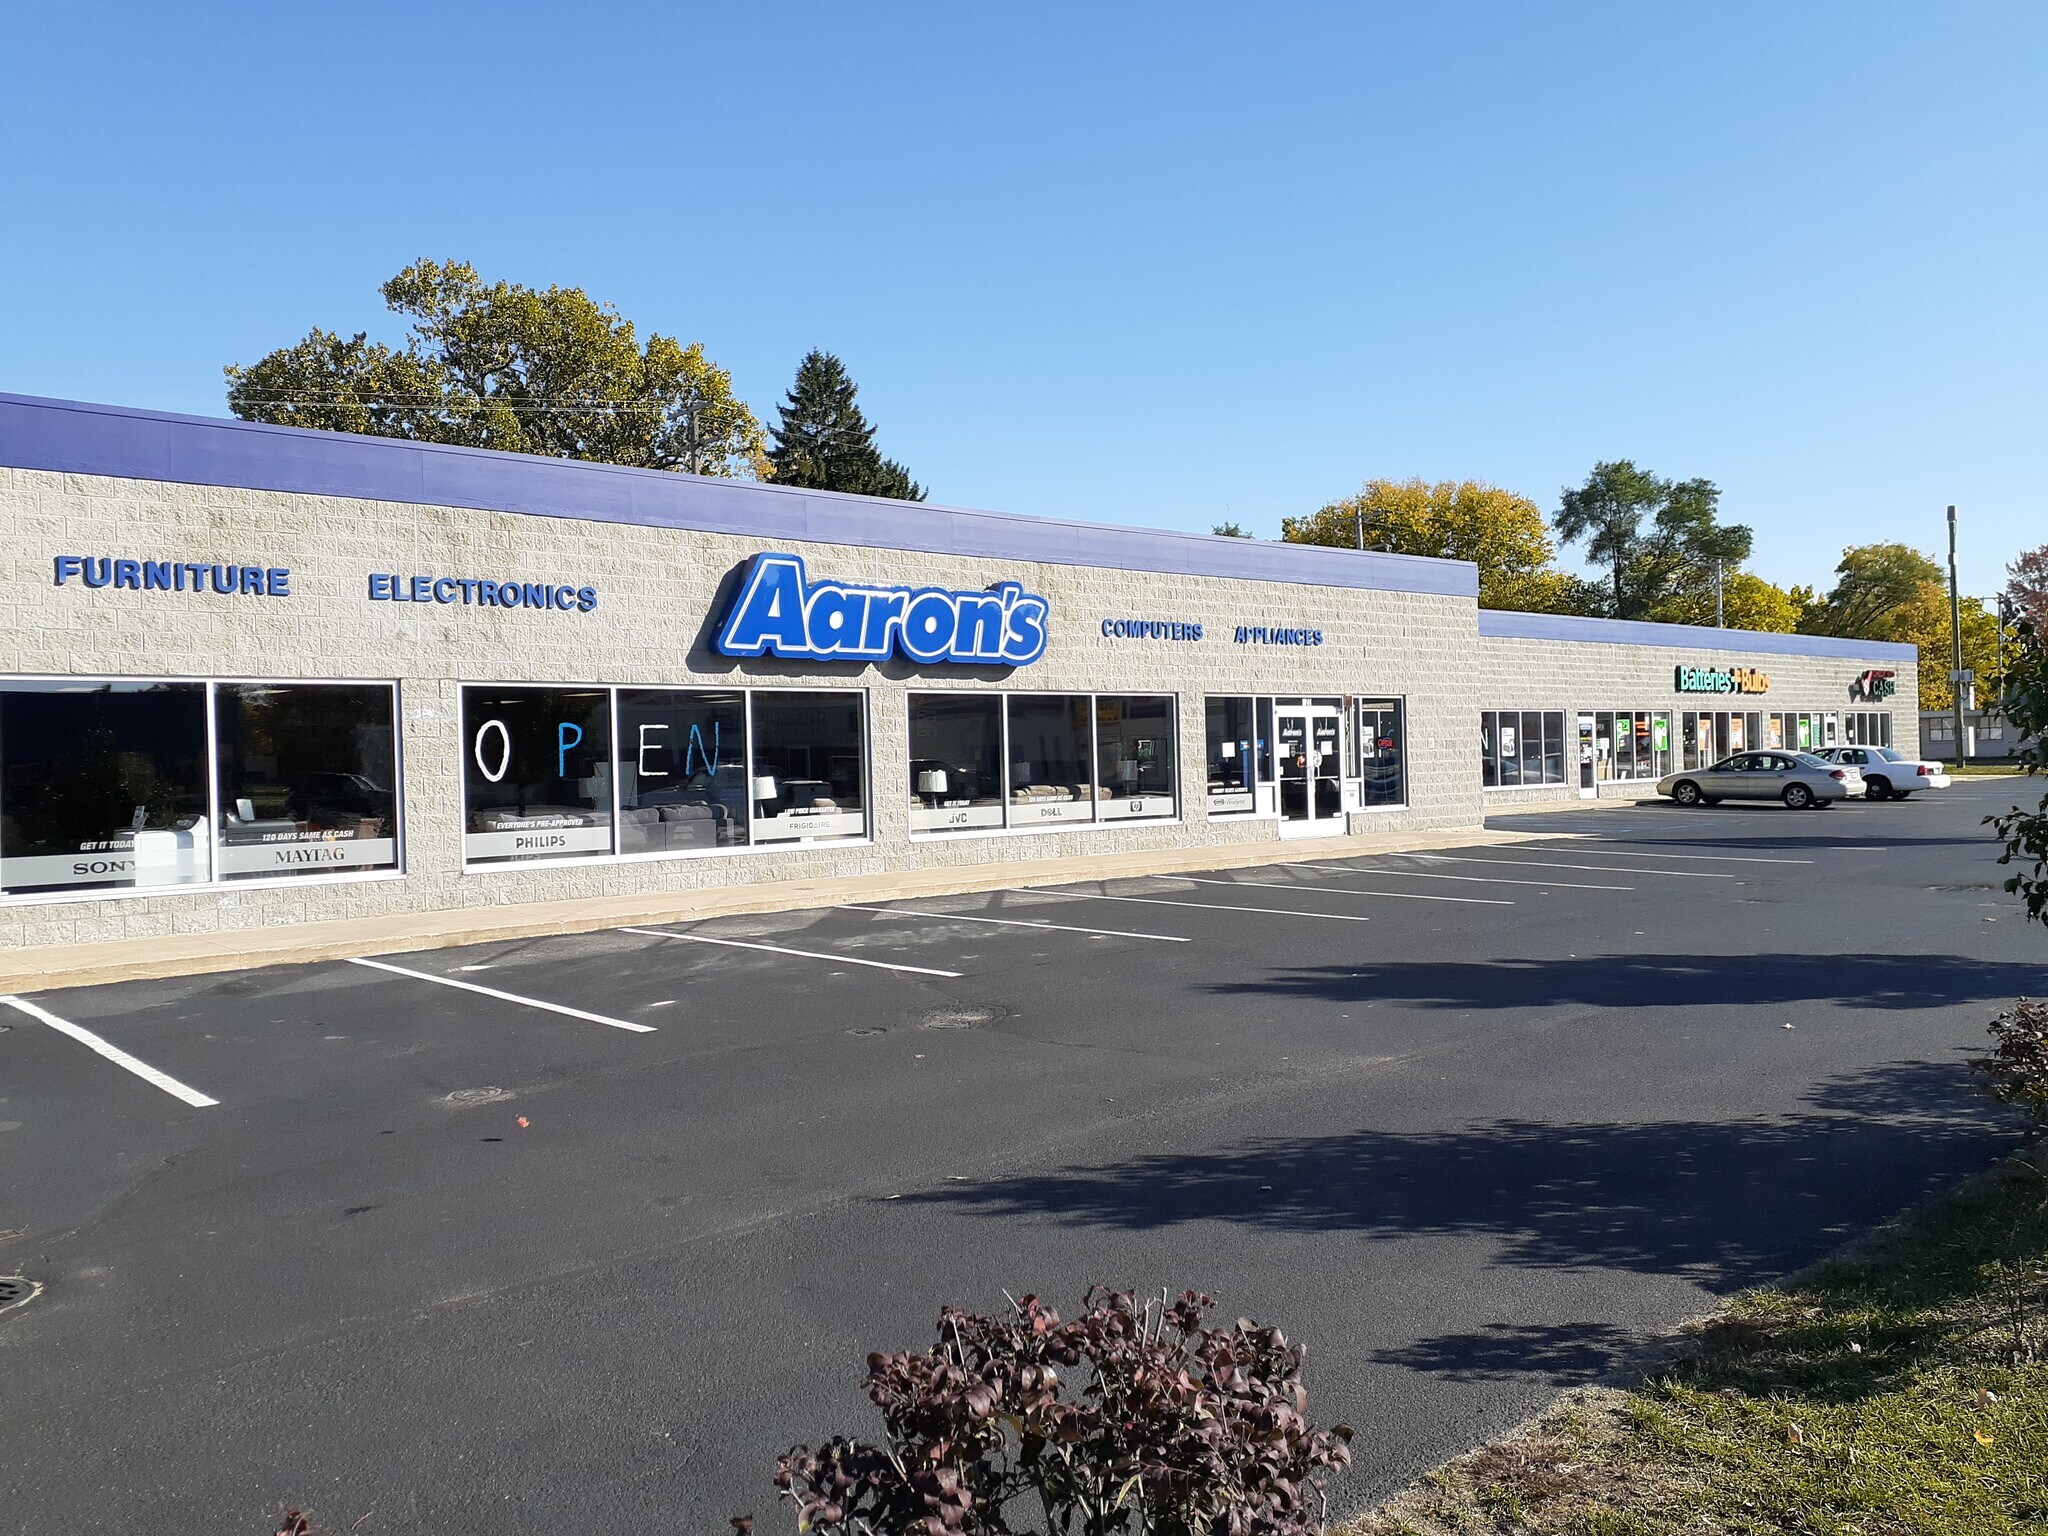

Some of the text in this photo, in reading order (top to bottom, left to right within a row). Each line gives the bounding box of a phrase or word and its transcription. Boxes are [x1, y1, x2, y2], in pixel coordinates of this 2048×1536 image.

[54, 555, 291, 597] FURNITURE
[369, 573, 597, 612] ELECTRONICS
[720, 554, 1049, 664] Aaron's
[1101, 618, 1204, 641] COMPUTERS
[1234, 626, 1324, 646] APPLIANCES
[1872, 680, 1896, 696] CASH
[948, 812, 968, 824] JVC
[1040, 807, 1063, 818] DELL
[496, 818, 584, 830] EVERYONE'S PRE-APPROVED
[789, 821, 831, 830] FRIGIDAIRE
[262, 829, 354, 842] 120 DAYS SAME AS CASH
[515, 835, 566, 849] PHILIPS
[80, 841, 97, 851] GET
[98, 841, 108, 850] IT
[274, 847, 345, 864] MAYTAG
